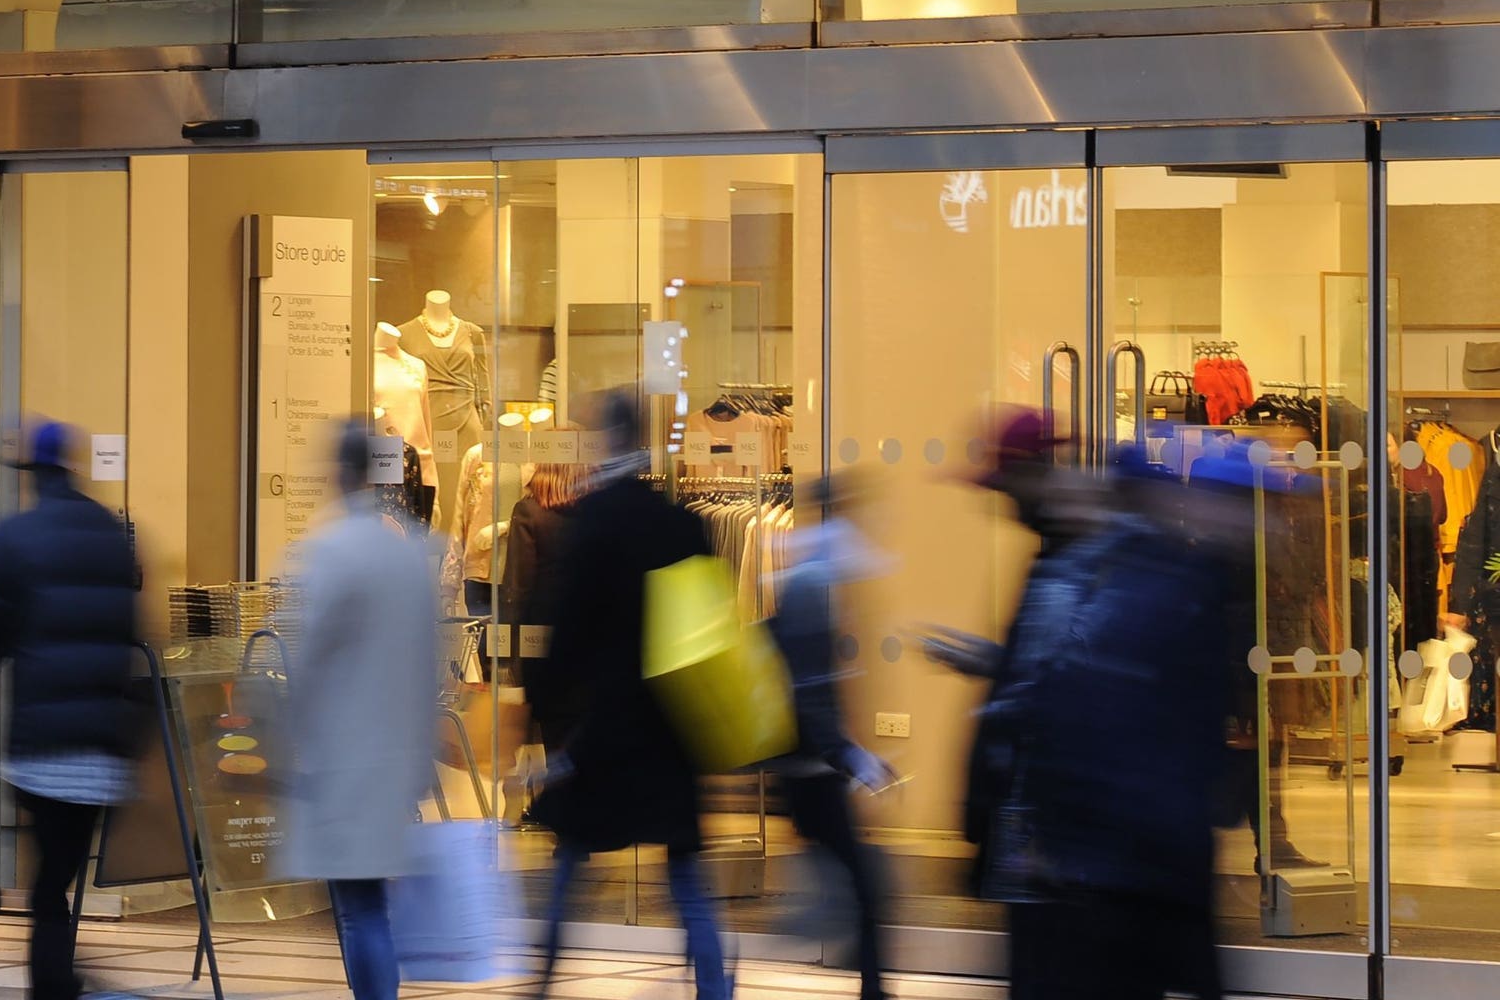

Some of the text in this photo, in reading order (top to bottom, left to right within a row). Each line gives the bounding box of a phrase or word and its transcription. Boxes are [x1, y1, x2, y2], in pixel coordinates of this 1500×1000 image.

[275, 241, 346, 266] Store guide
[271, 295, 283, 317] 2
[287, 308, 316, 320] Luggage
[287, 320, 310, 331] Bureau
[287, 346, 306, 356] Order
[313, 346, 334, 357] Collect
[271, 397, 319, 419] 1 Menswear
[437, 440, 453, 449] M&S
[371, 451, 399, 460] Automatic
[378, 461, 392, 469] door
[269, 473, 284, 497] G
[287, 499, 316, 509] Footwear
